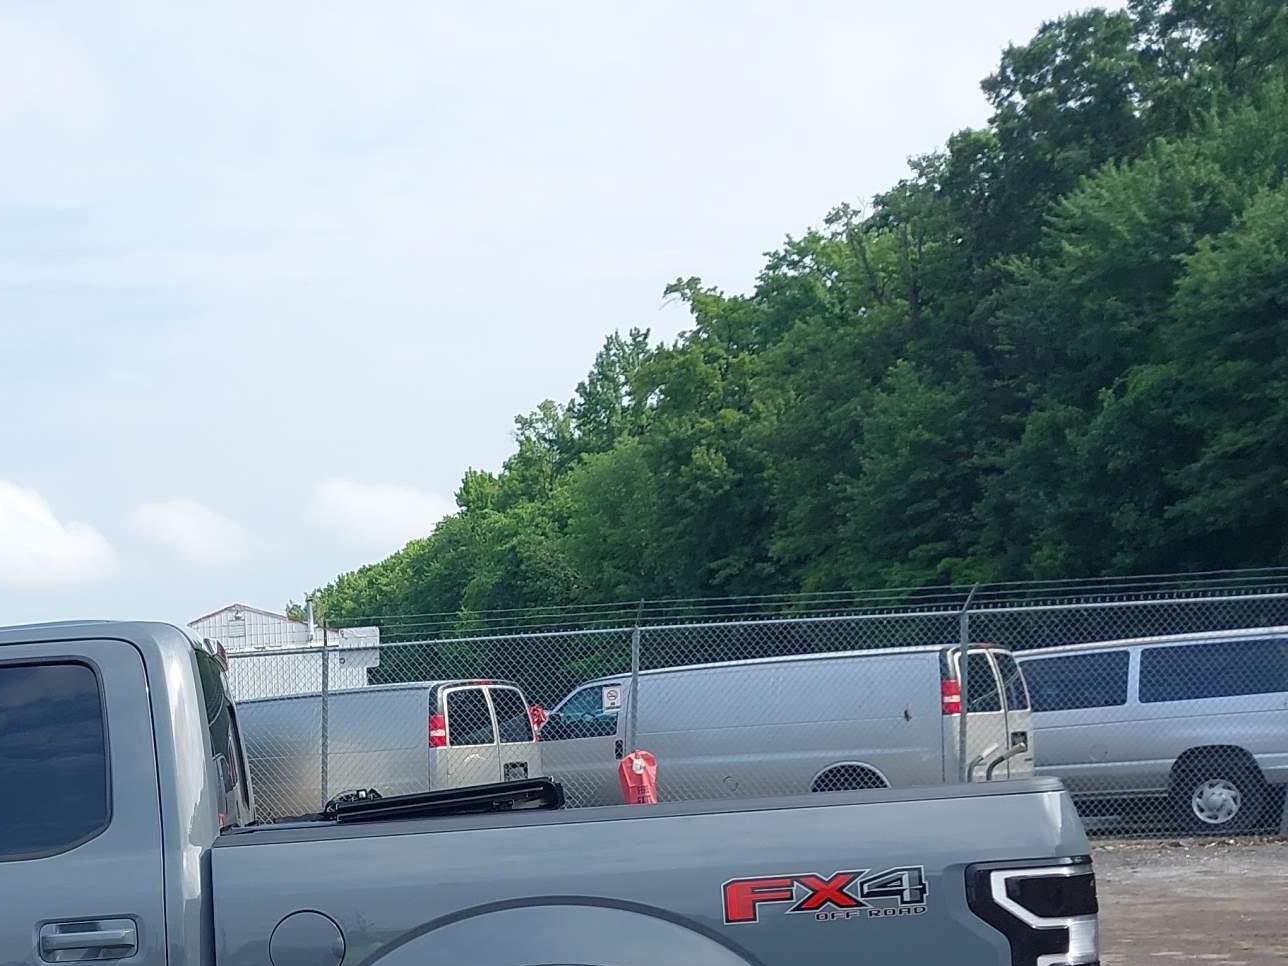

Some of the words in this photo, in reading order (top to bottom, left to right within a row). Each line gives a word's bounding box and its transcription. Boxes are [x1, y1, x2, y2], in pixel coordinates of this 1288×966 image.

[721, 865, 929, 925] FX4
[815, 911, 860, 922] OFF
[868, 906, 928, 919] ROAD
